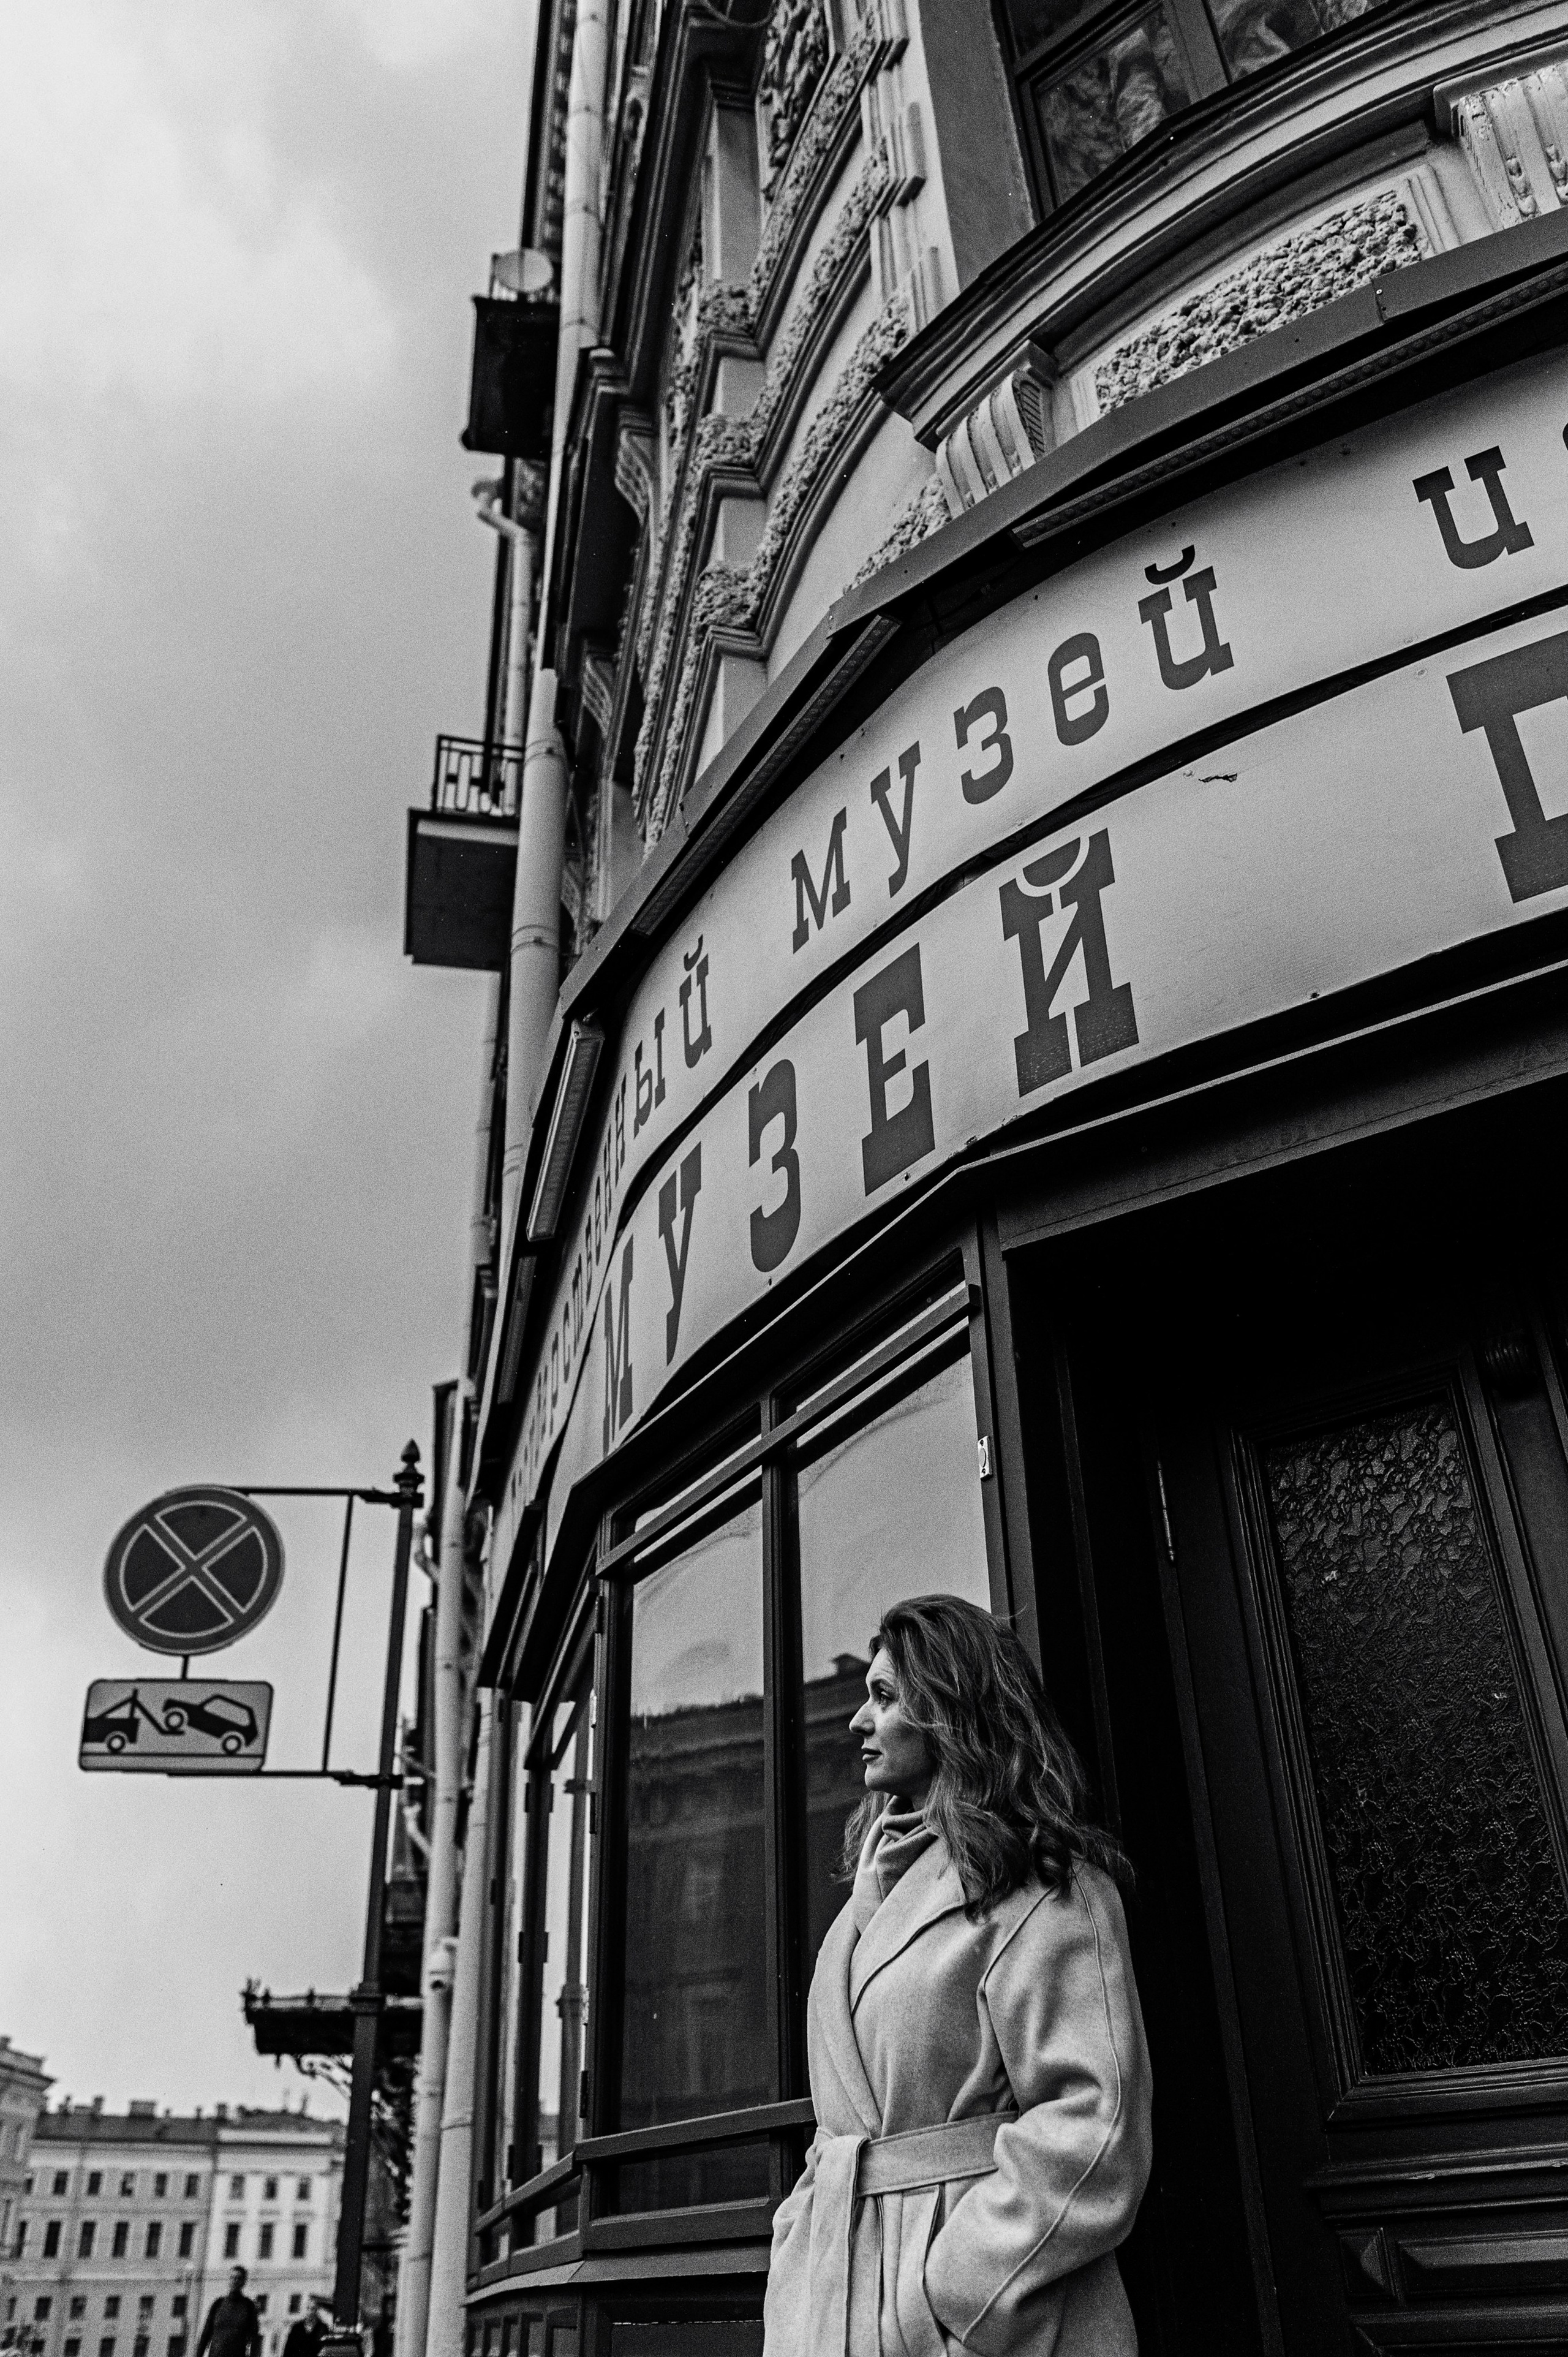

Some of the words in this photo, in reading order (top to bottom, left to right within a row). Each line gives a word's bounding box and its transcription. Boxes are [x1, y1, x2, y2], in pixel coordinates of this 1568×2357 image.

[791, 545, 1234, 953] музей
[1412, 422, 1568, 569] и
[603, 828, 1139, 1459] МУЗЕЙ
